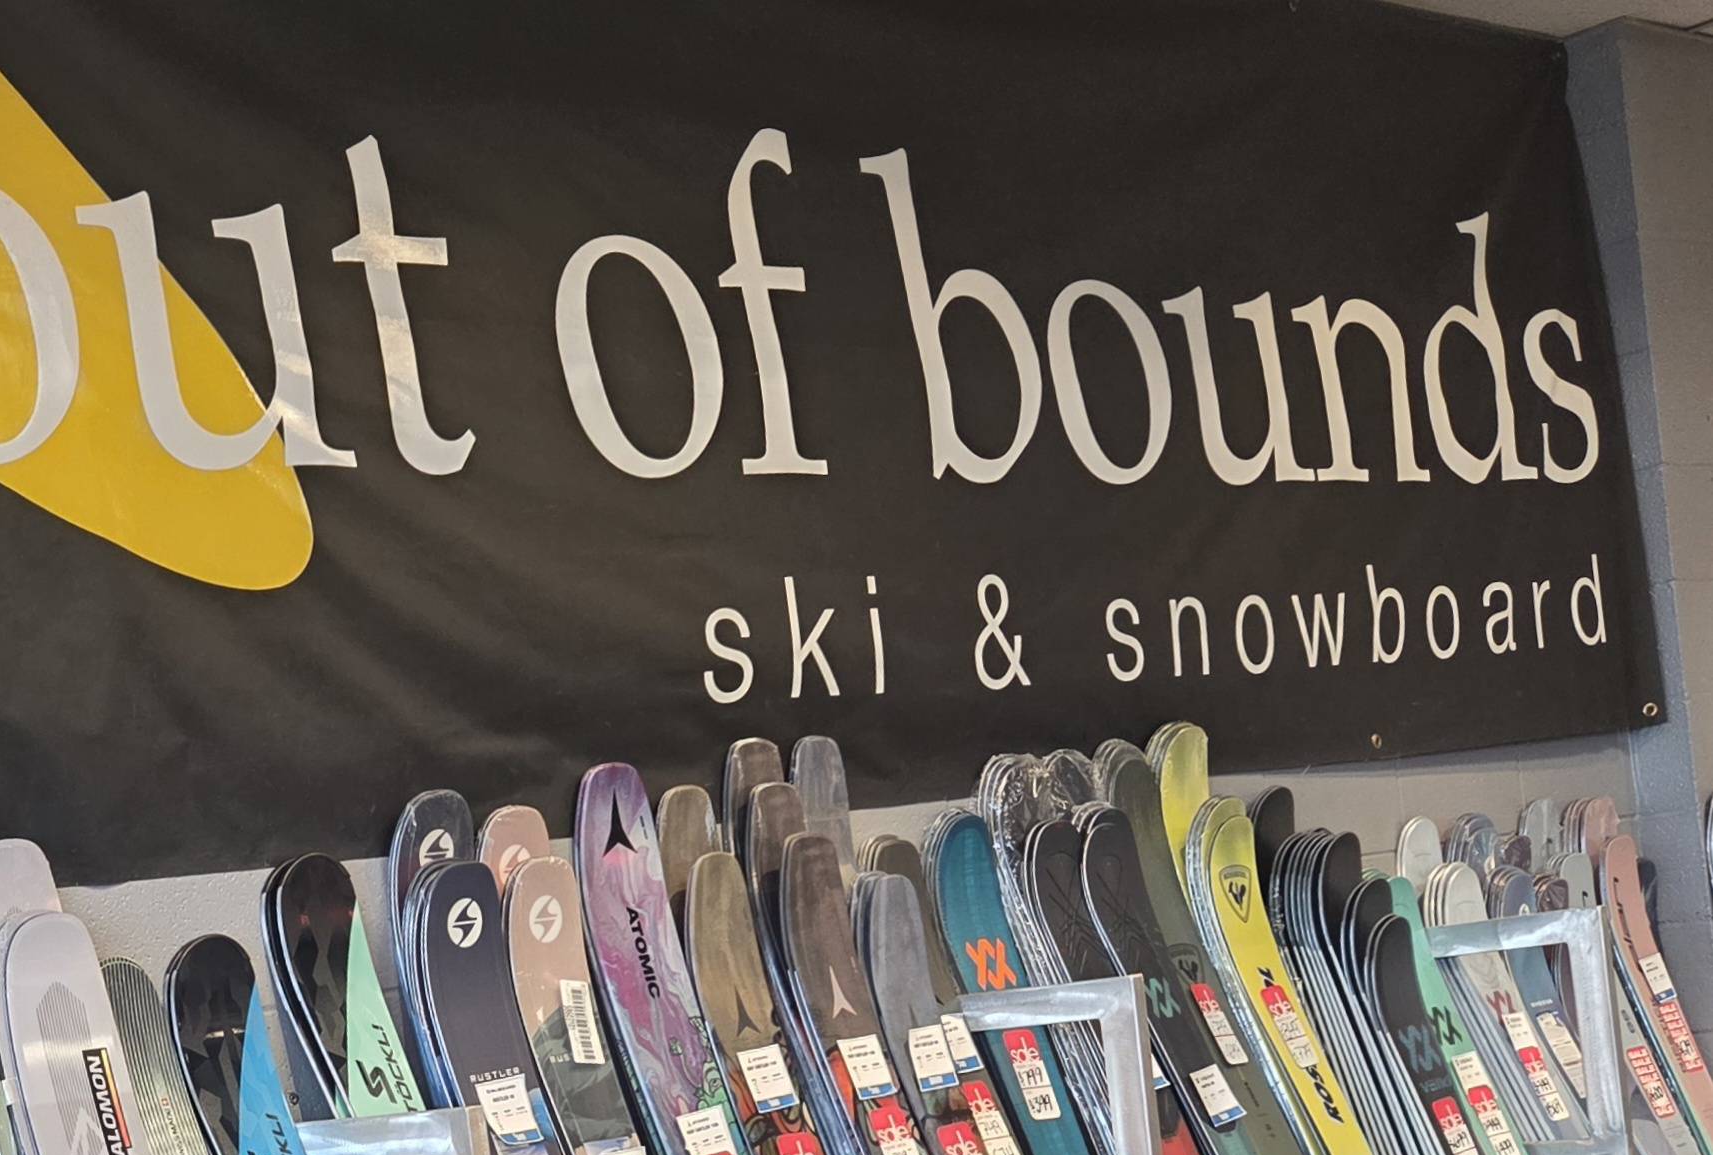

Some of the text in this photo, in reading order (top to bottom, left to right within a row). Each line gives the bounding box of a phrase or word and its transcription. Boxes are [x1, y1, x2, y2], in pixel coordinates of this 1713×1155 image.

[556, 128, 828, 478] of
[860, 149, 1600, 485] bounds
[704, 554, 1608, 704] ski & snowboard
[626, 905, 661, 999] ATOMIC
[469, 1066, 520, 1083] RUSTLER
